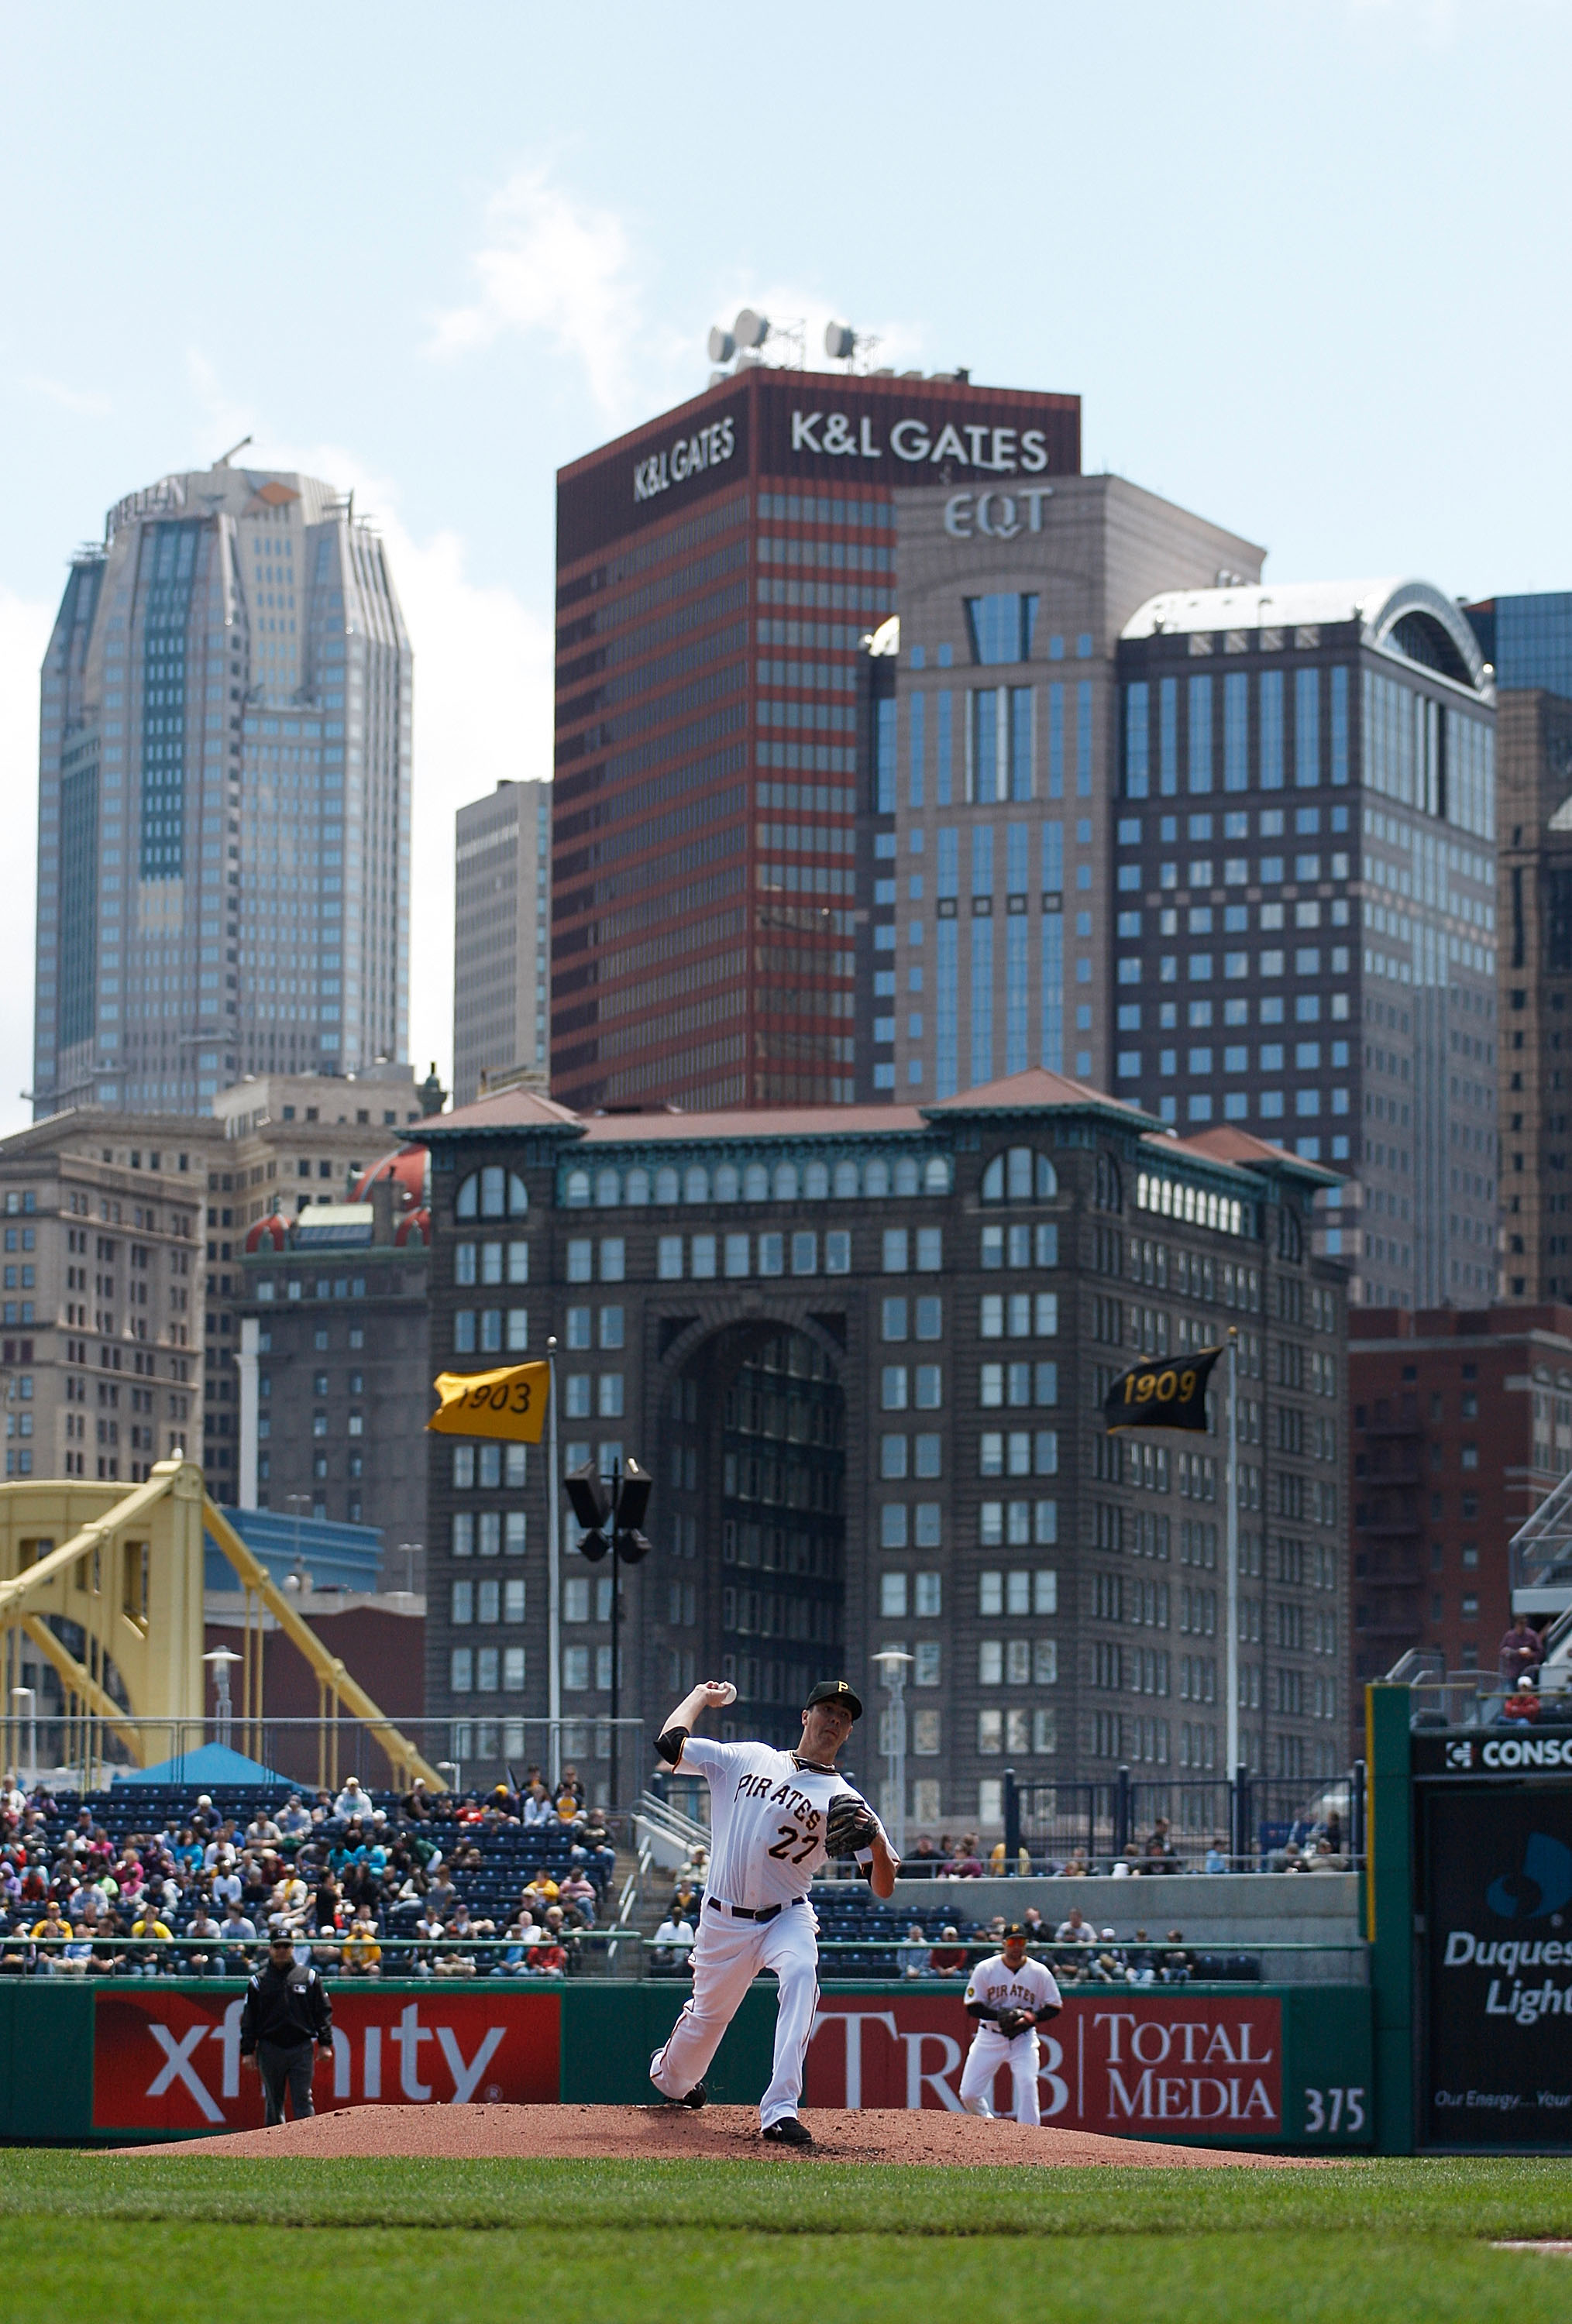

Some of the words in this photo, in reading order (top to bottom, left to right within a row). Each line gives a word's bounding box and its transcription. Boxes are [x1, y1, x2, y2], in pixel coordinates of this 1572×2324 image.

[634, 452, 670, 502] K&L
[670, 415, 735, 482] GATES
[791, 410, 882, 459] K&L
[890, 419, 1049, 472] GATES
[944, 486, 1054, 539] EQT
[458, 1382, 531, 1415] 1903
[1124, 1370, 1197, 1404] 1909
[838, 1680, 850, 1693] P
[733, 1772, 821, 1831] PIRATES
[768, 1825, 820, 1865] 27
[986, 1983, 1036, 2006] PIRATES
[1485, 1978, 1572, 2026] Light
[146, 1999, 507, 2123] xfnity
[1093, 2013, 1273, 2064] TOTAL
[810, 2011, 1069, 2118] TRB
[1106, 2068, 1278, 2119] MEDIA
[1305, 2088, 1365, 2132] 375
[1434, 2090, 1464, 2107] Our
